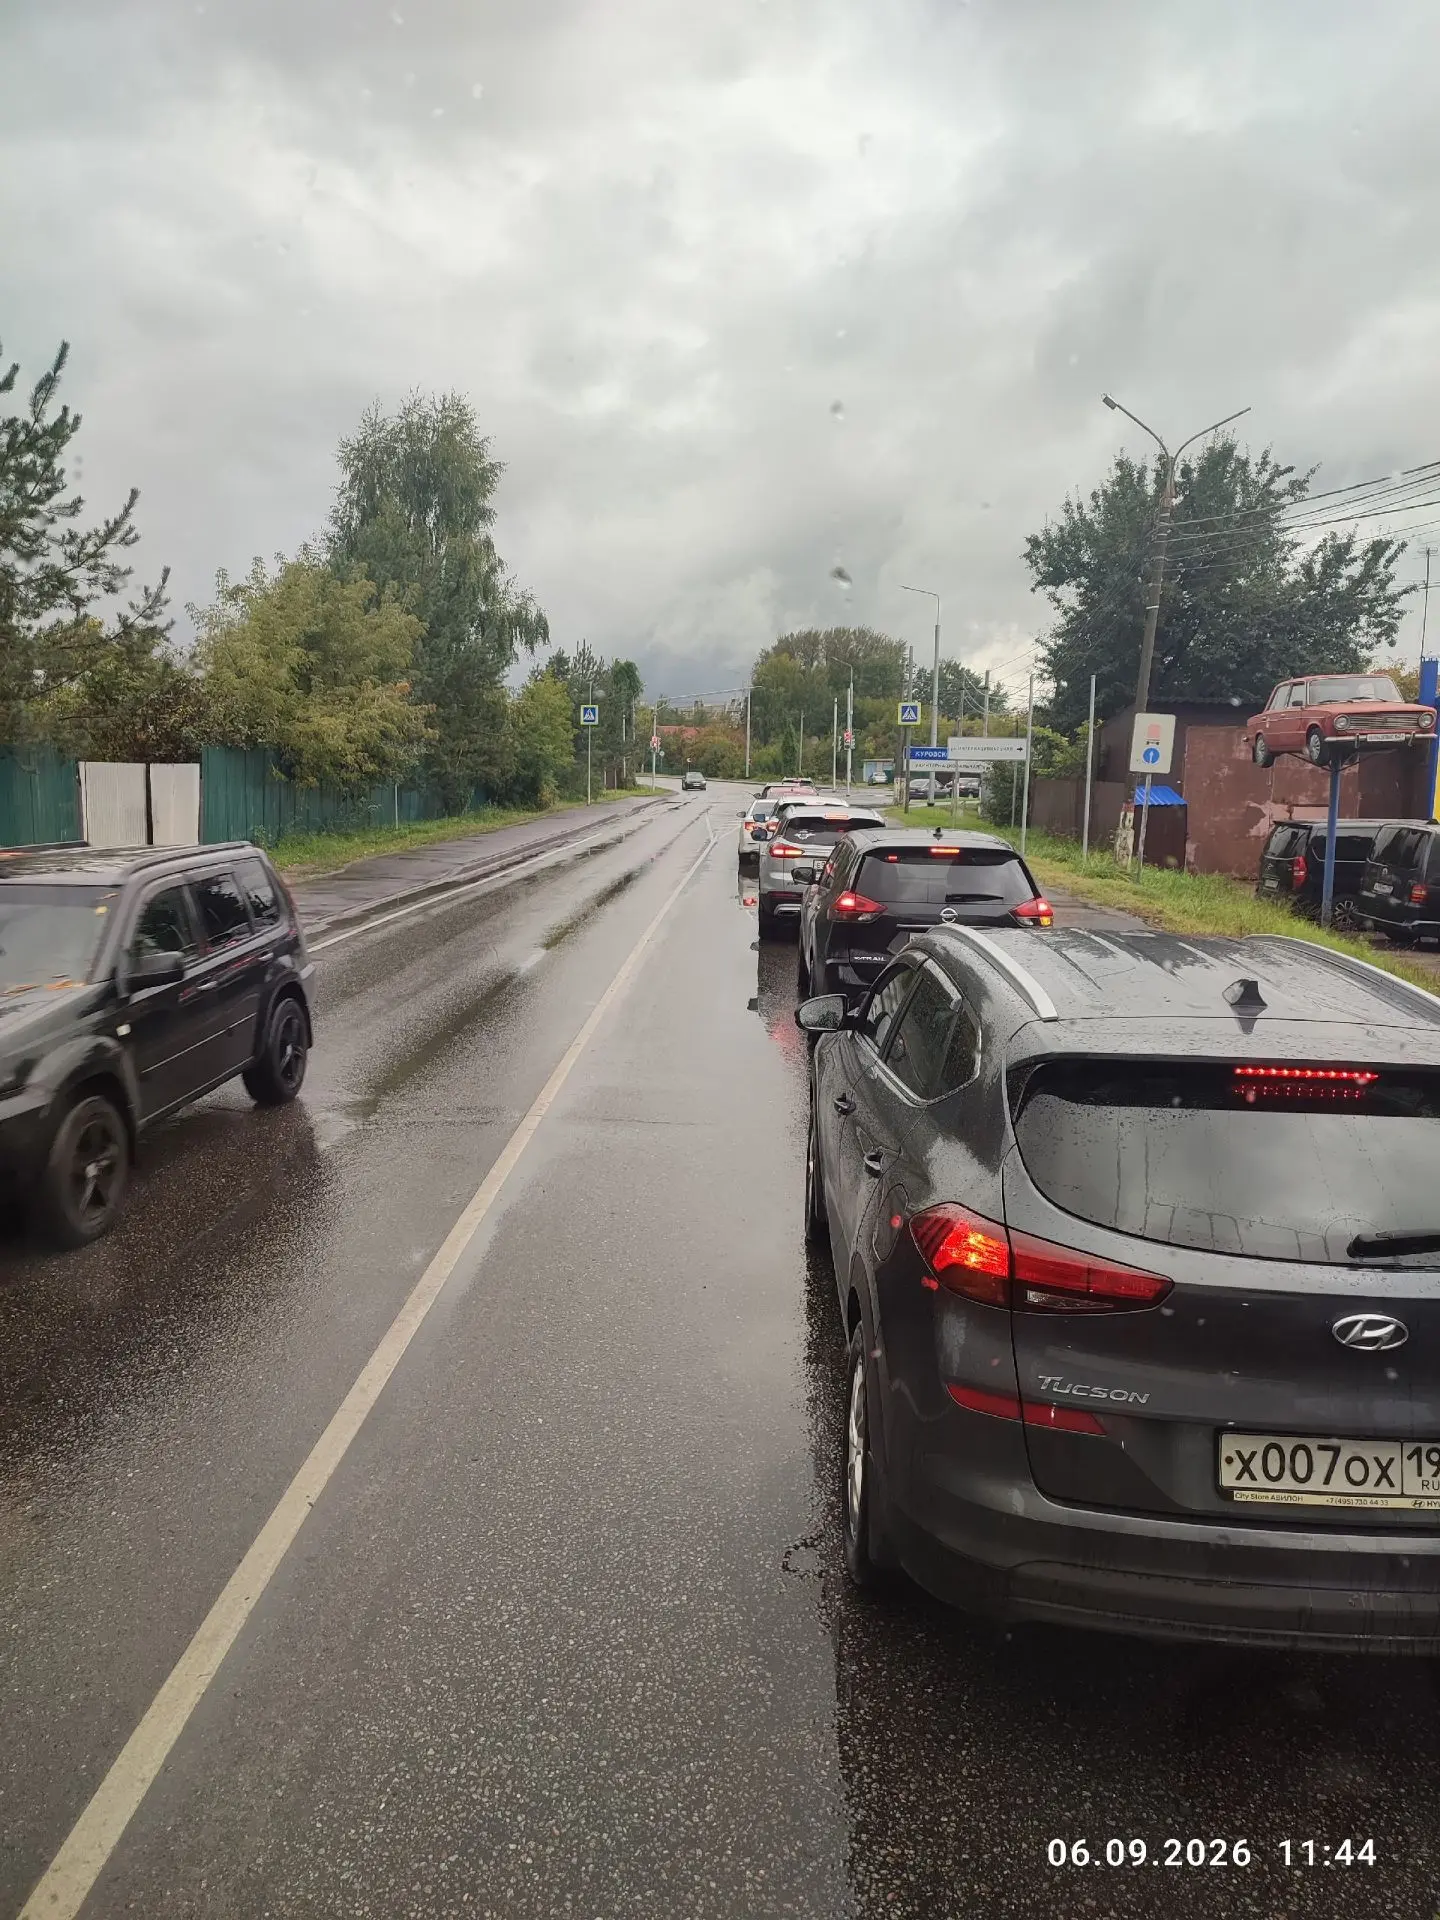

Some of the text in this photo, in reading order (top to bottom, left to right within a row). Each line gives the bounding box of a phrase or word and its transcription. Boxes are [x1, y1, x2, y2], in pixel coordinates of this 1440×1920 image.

[1406, 1446, 1440, 1478] 19
[1421, 1479, 1440, 1491] RU
[1235, 1492, 1249, 1500] City
